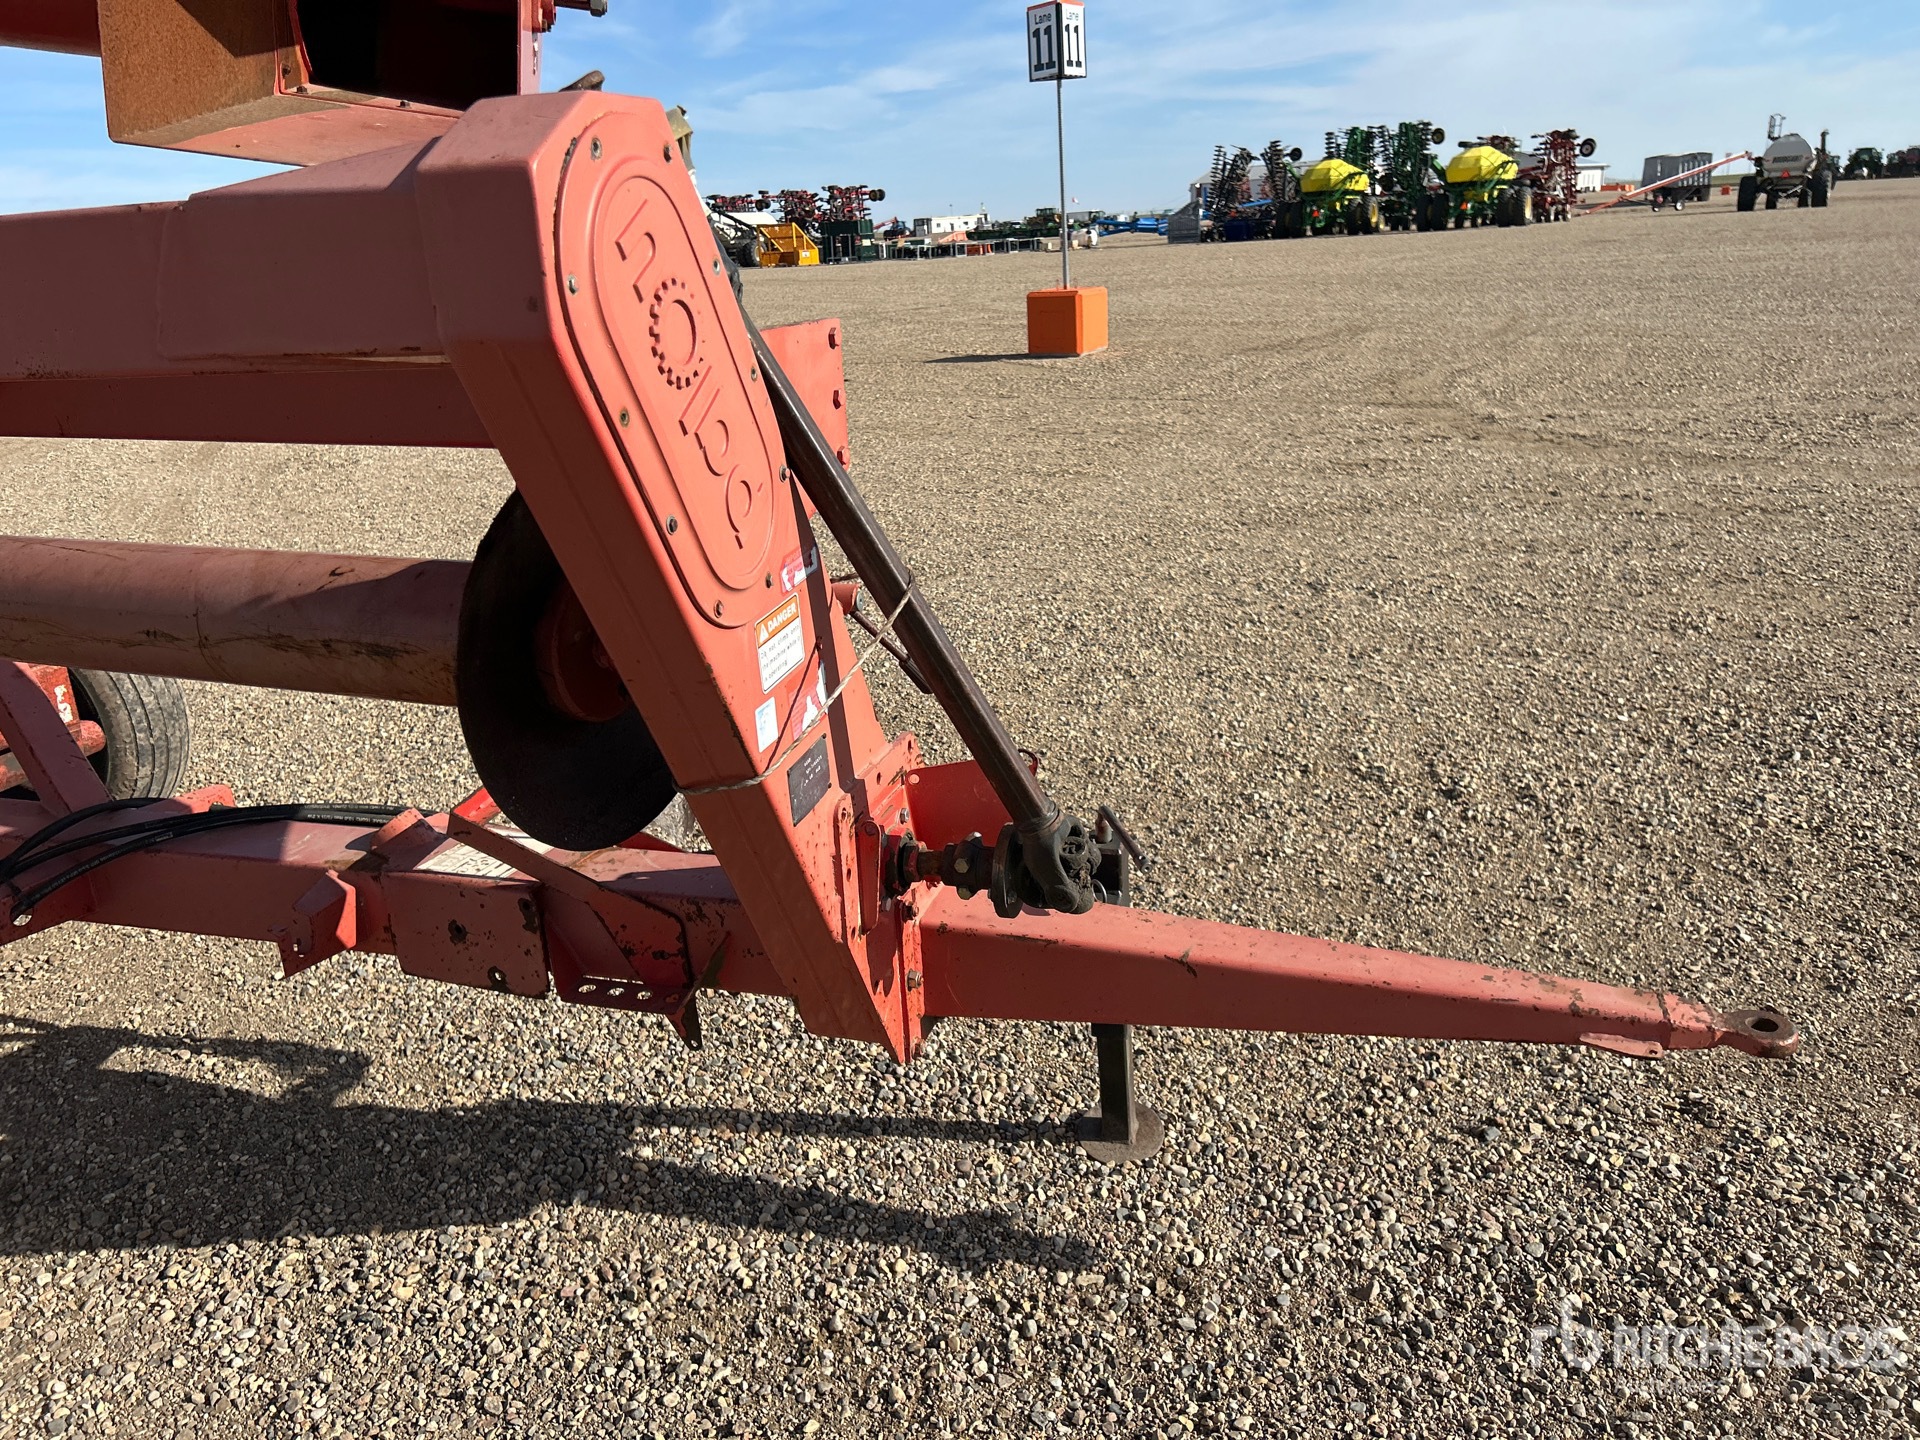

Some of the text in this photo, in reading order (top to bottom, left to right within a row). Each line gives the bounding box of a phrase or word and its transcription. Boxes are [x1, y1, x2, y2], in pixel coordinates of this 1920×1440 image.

[1034, 13, 1051, 25] Lane
[1032, 25, 1056, 72] 11
[1065, 24, 1082, 68] 11
[768, 602, 797, 632] DANGER
[769, 648, 786, 665] machine
[787, 639, 797, 650] while
[768, 659, 788, 679] operating
